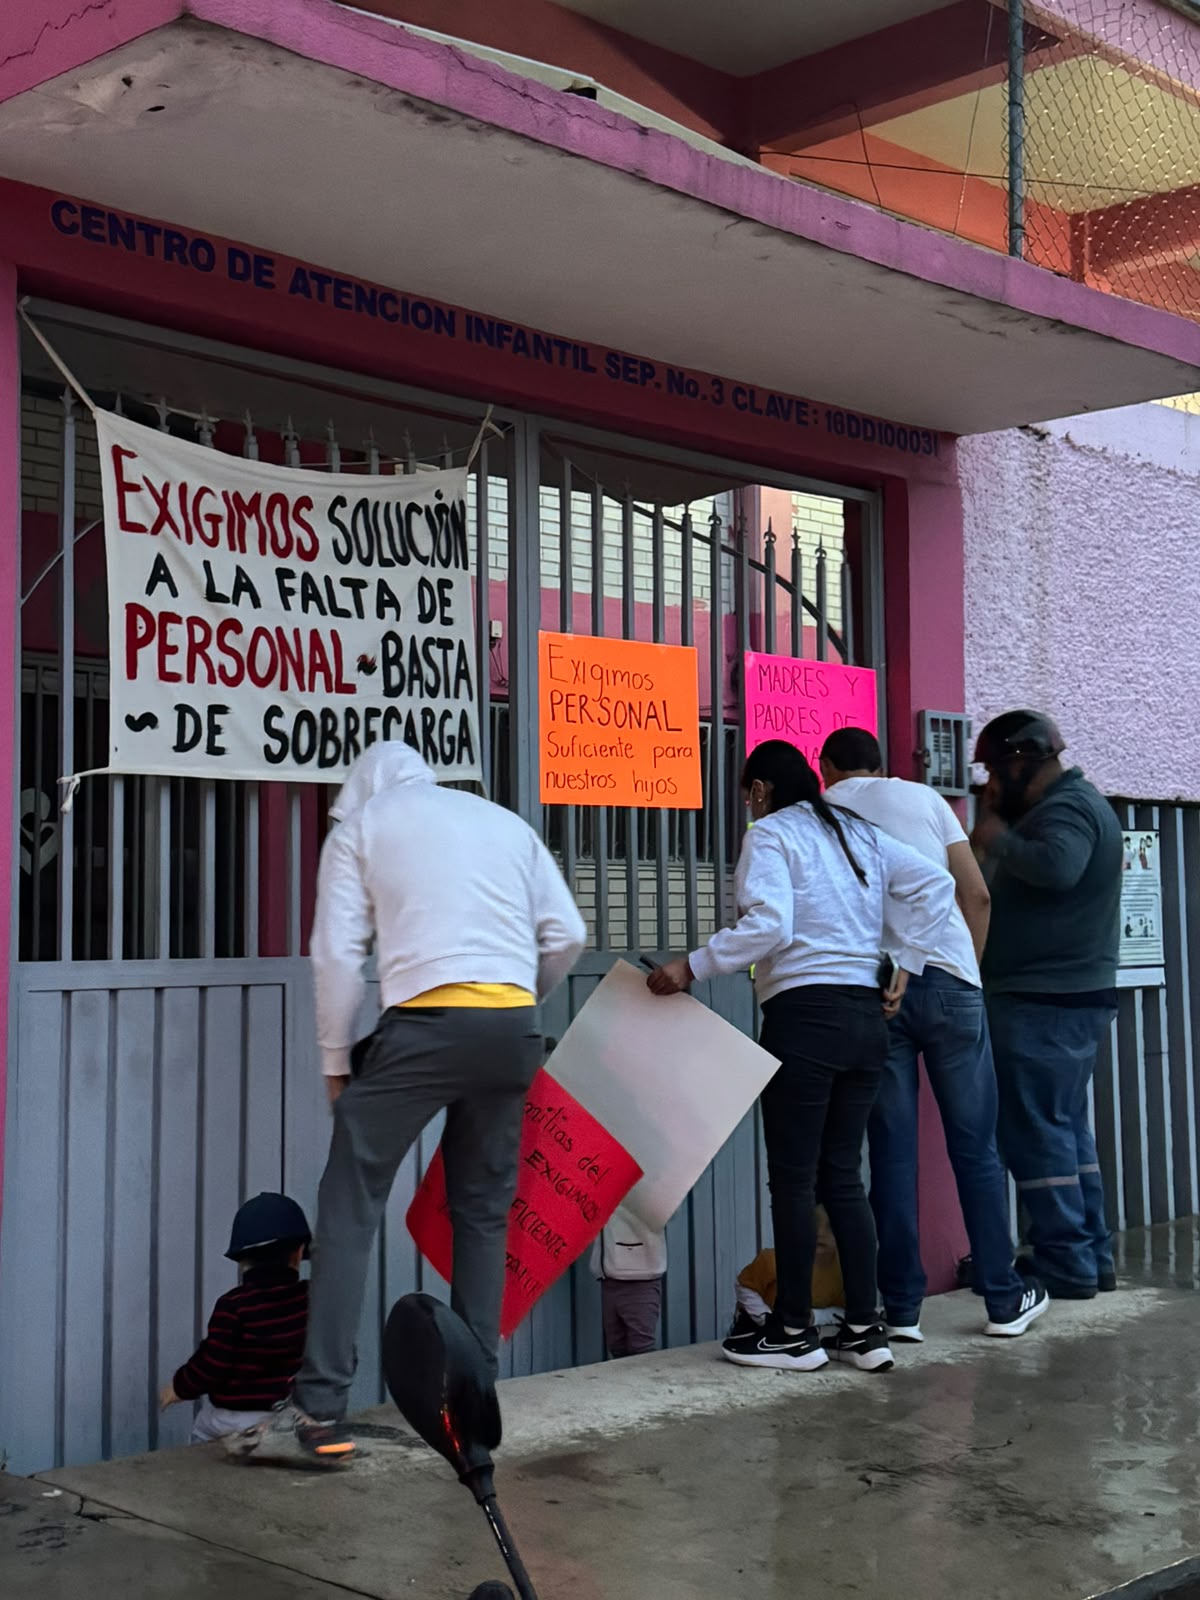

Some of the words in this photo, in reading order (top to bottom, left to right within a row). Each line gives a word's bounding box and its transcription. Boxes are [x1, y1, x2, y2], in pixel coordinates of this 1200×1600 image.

[51, 200, 215, 273] CENTRO
[227, 248, 275, 289] DE
[288, 267, 456, 337] ATENCION
[465, 314, 596, 373] INFANTIL
[605, 353, 661, 389] SEP.
[732, 386, 819, 427] CLAVE:
[112, 444, 320, 562] EXIGIMOS
[327, 489, 469, 571] SOLUCIÓN
[145, 552, 178, 598] A
[203, 560, 262, 608] LA
[275, 567, 401, 622] FALTA
[417, 576, 454, 626] DE
[125, 602, 357, 694] PERSONAL
[381, 630, 474, 701] BASTA
[549, 643, 654, 702] Exigimos
[758, 664, 829, 699] MADRES
[844, 673, 859, 696] Y
[172, 703, 231, 756] DE
[550, 689, 683, 732] PERSONAL
[754, 703, 822, 735] PADRES
[547, 731, 635, 758] Suficiente
[653, 745, 693, 768] para
[546, 769, 616, 790] nuestros
[632, 769, 678, 801] hijos
[524, 1149, 600, 1223] EXIGIMOS
[577, 1153, 609, 1186] del
[511, 1197, 567, 1260] FICIENTE
